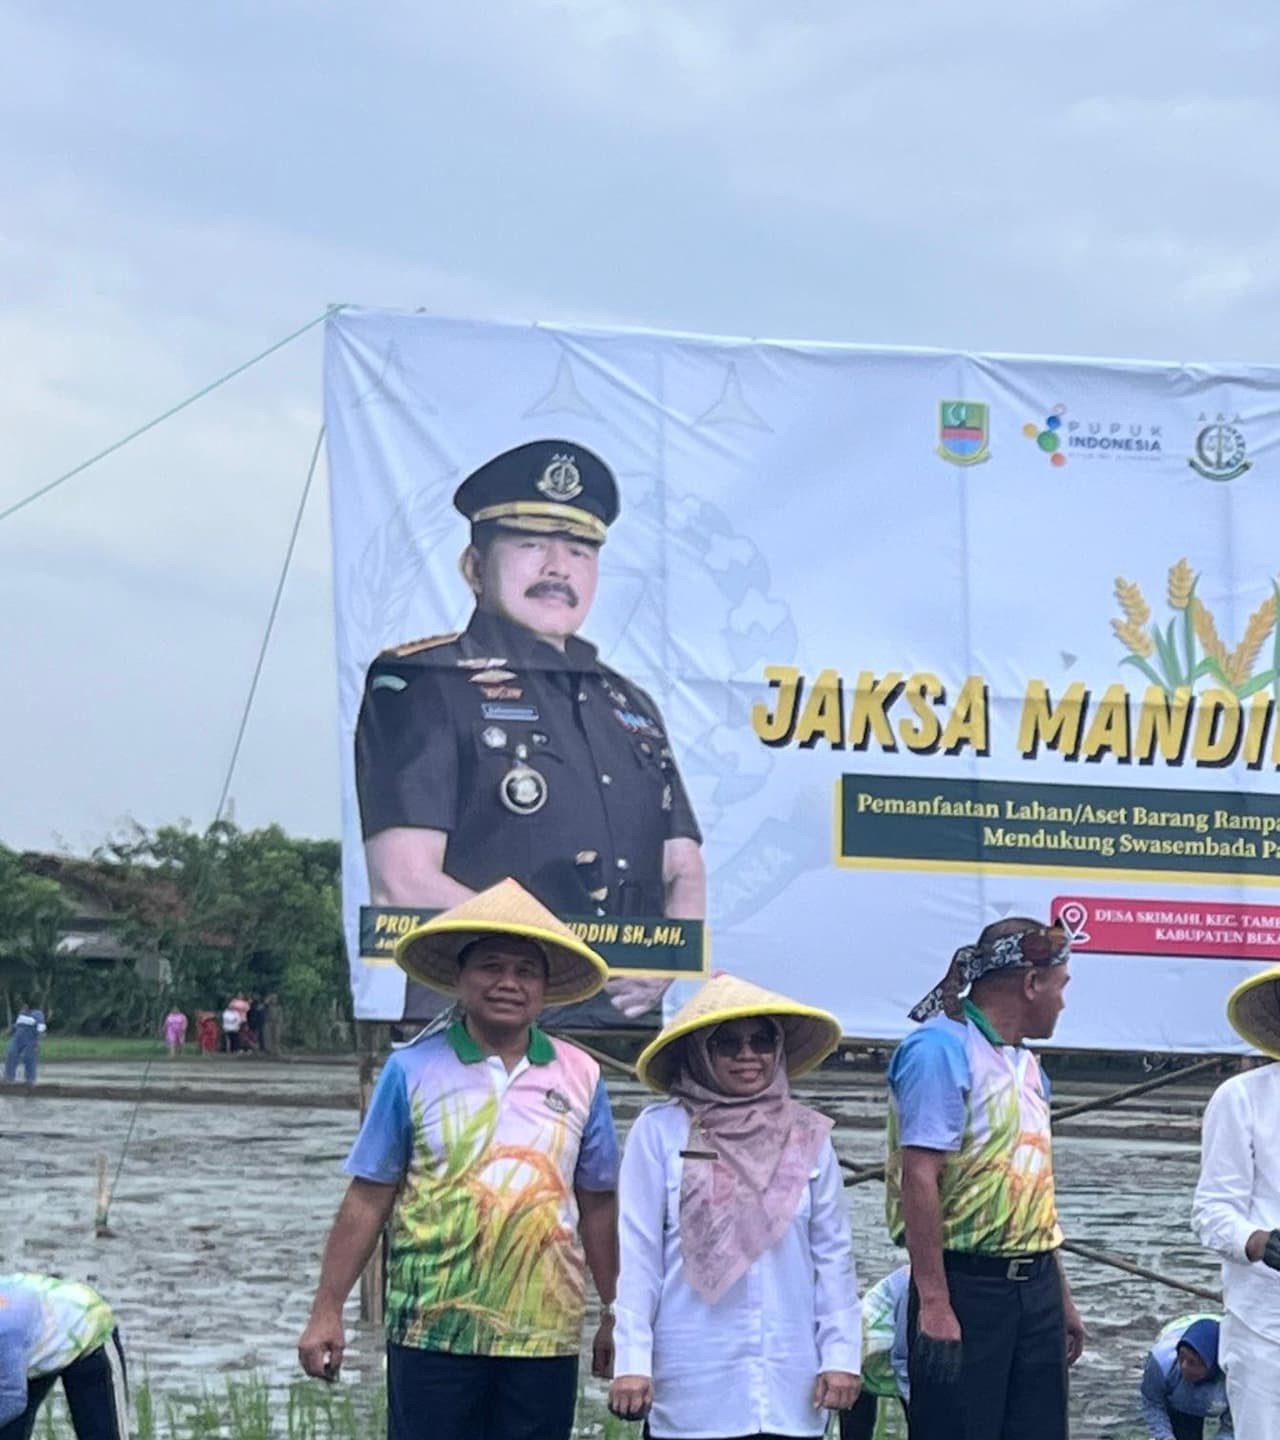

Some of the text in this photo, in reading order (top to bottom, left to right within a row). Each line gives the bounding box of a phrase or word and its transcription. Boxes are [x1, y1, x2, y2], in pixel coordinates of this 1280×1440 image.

[1066, 420, 1162, 437] PUPUK
[1068, 436, 1161, 452] INDONESIA
[750, 664, 990, 757] JAKSA
[857, 793, 999, 818] Pemanfaatan
[1005, 801, 1127, 826] Lahan/Aset
[1132, 807, 1209, 833] Barang
[983, 826, 1115, 855] Mendukung
[1119, 834, 1256, 858] Swasembada
[1095, 908, 1134, 923] DESA
[1206, 914, 1239, 927] KEC.
[1155, 928, 1243, 943] KABUPATEN
